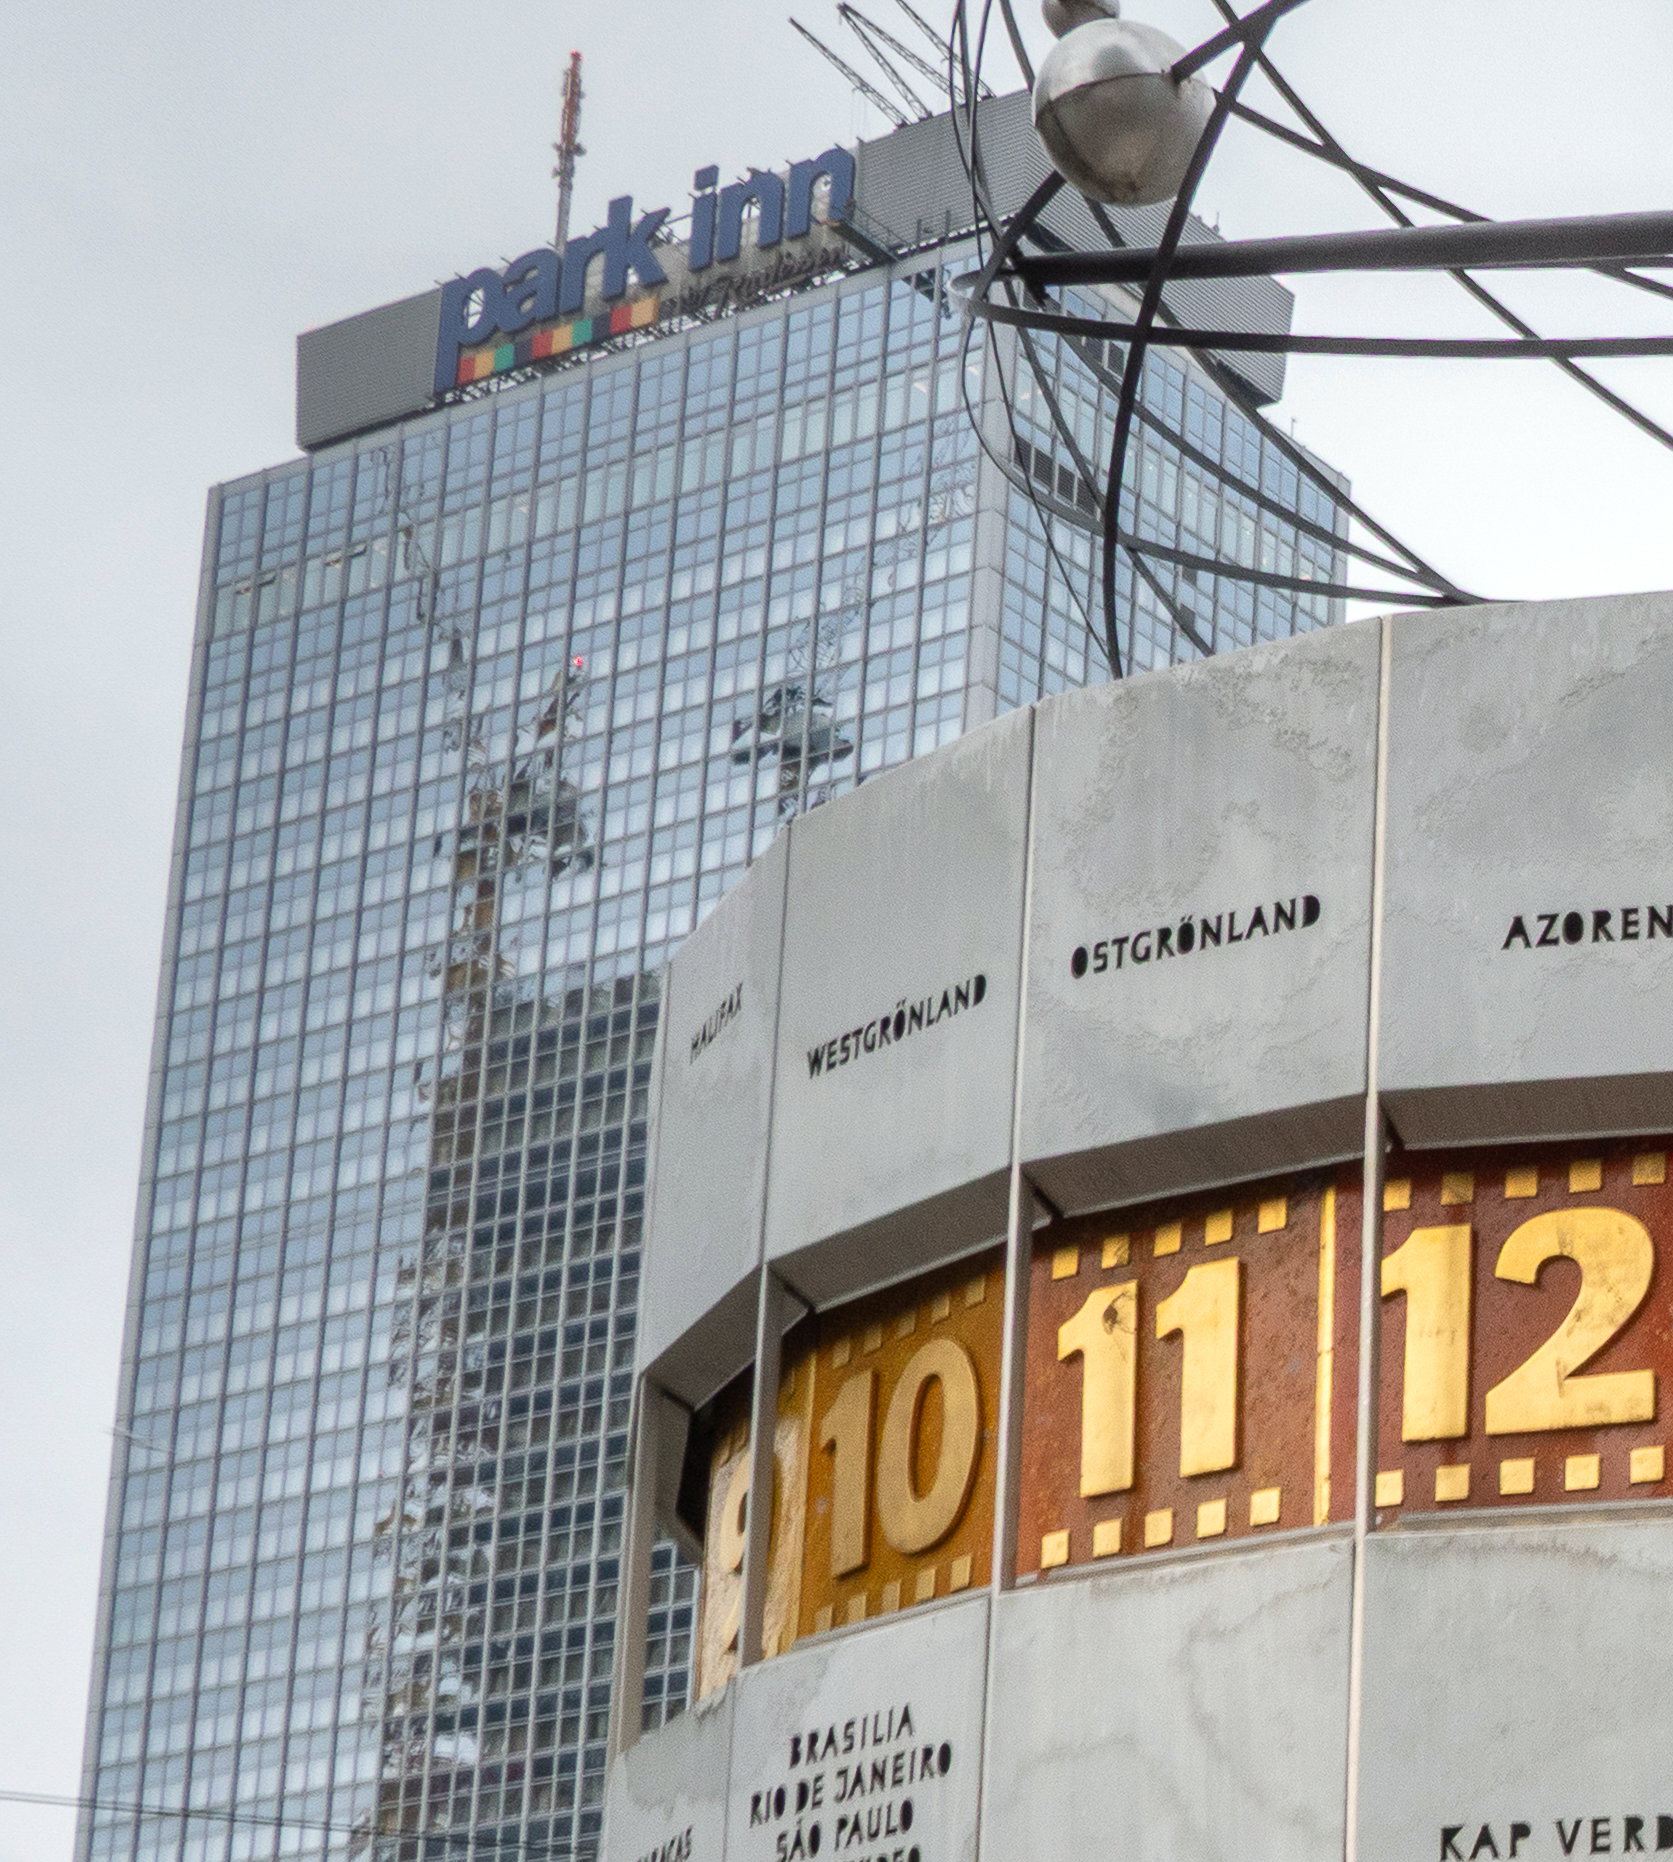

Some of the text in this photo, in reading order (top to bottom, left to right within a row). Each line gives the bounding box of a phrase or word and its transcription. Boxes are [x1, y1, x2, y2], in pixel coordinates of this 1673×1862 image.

[434, 148, 856, 394] park inn
[1071, 895, 1320, 979] OSTGRÖNLAND
[1501, 904, 1673, 950] AZOREN
[807, 974, 986, 1078] WESTGRÖNLAND
[1381, 1208, 1656, 1441] 12
[1057, 1257, 1240, 1498] 11
[820, 1338, 978, 1578] 10
[789, 1705, 914, 1769] BRASILIA
[749, 1741, 951, 1828] RIO DE JANEIRO
[835, 1798, 913, 1851] PAULO
[1439, 1822, 1531, 1862] KAP
